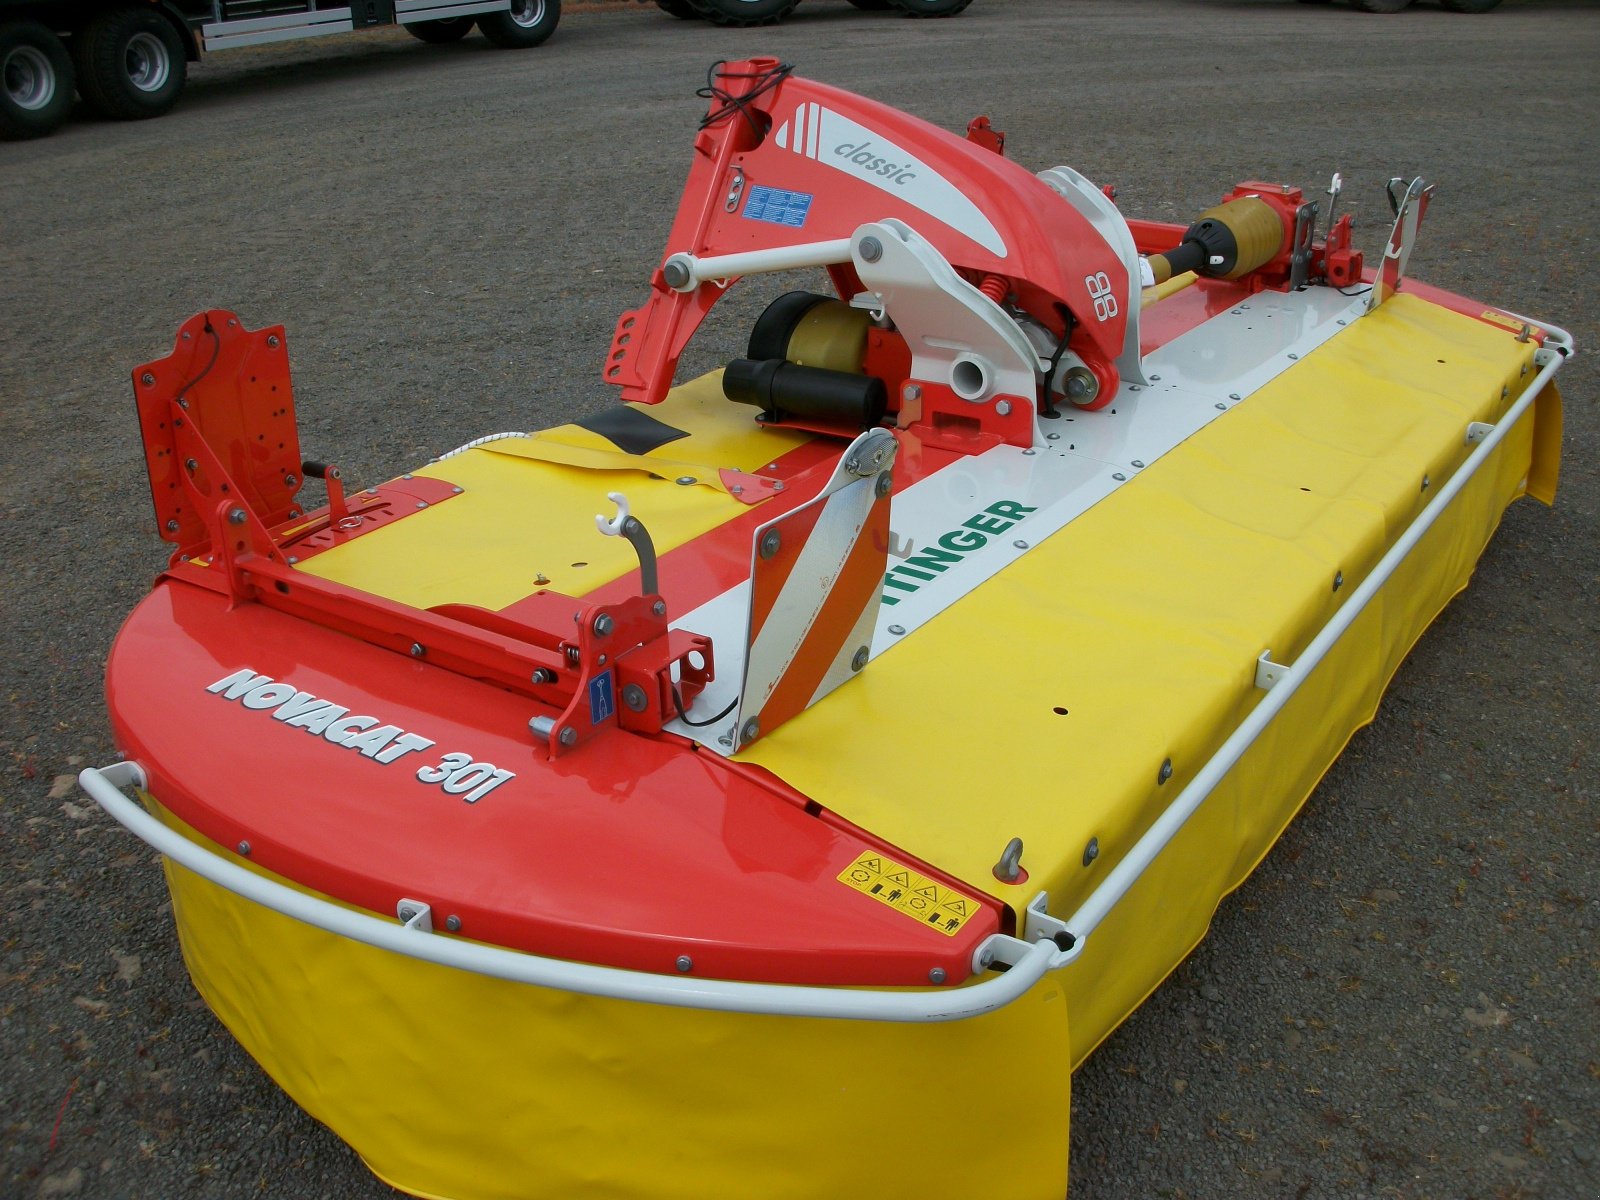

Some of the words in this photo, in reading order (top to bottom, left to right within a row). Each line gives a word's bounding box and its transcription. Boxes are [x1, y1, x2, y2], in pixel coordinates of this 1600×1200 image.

[833, 142, 916, 185] classic
[206, 668, 436, 766] NOVACAT
[416, 752, 516, 804] 301
